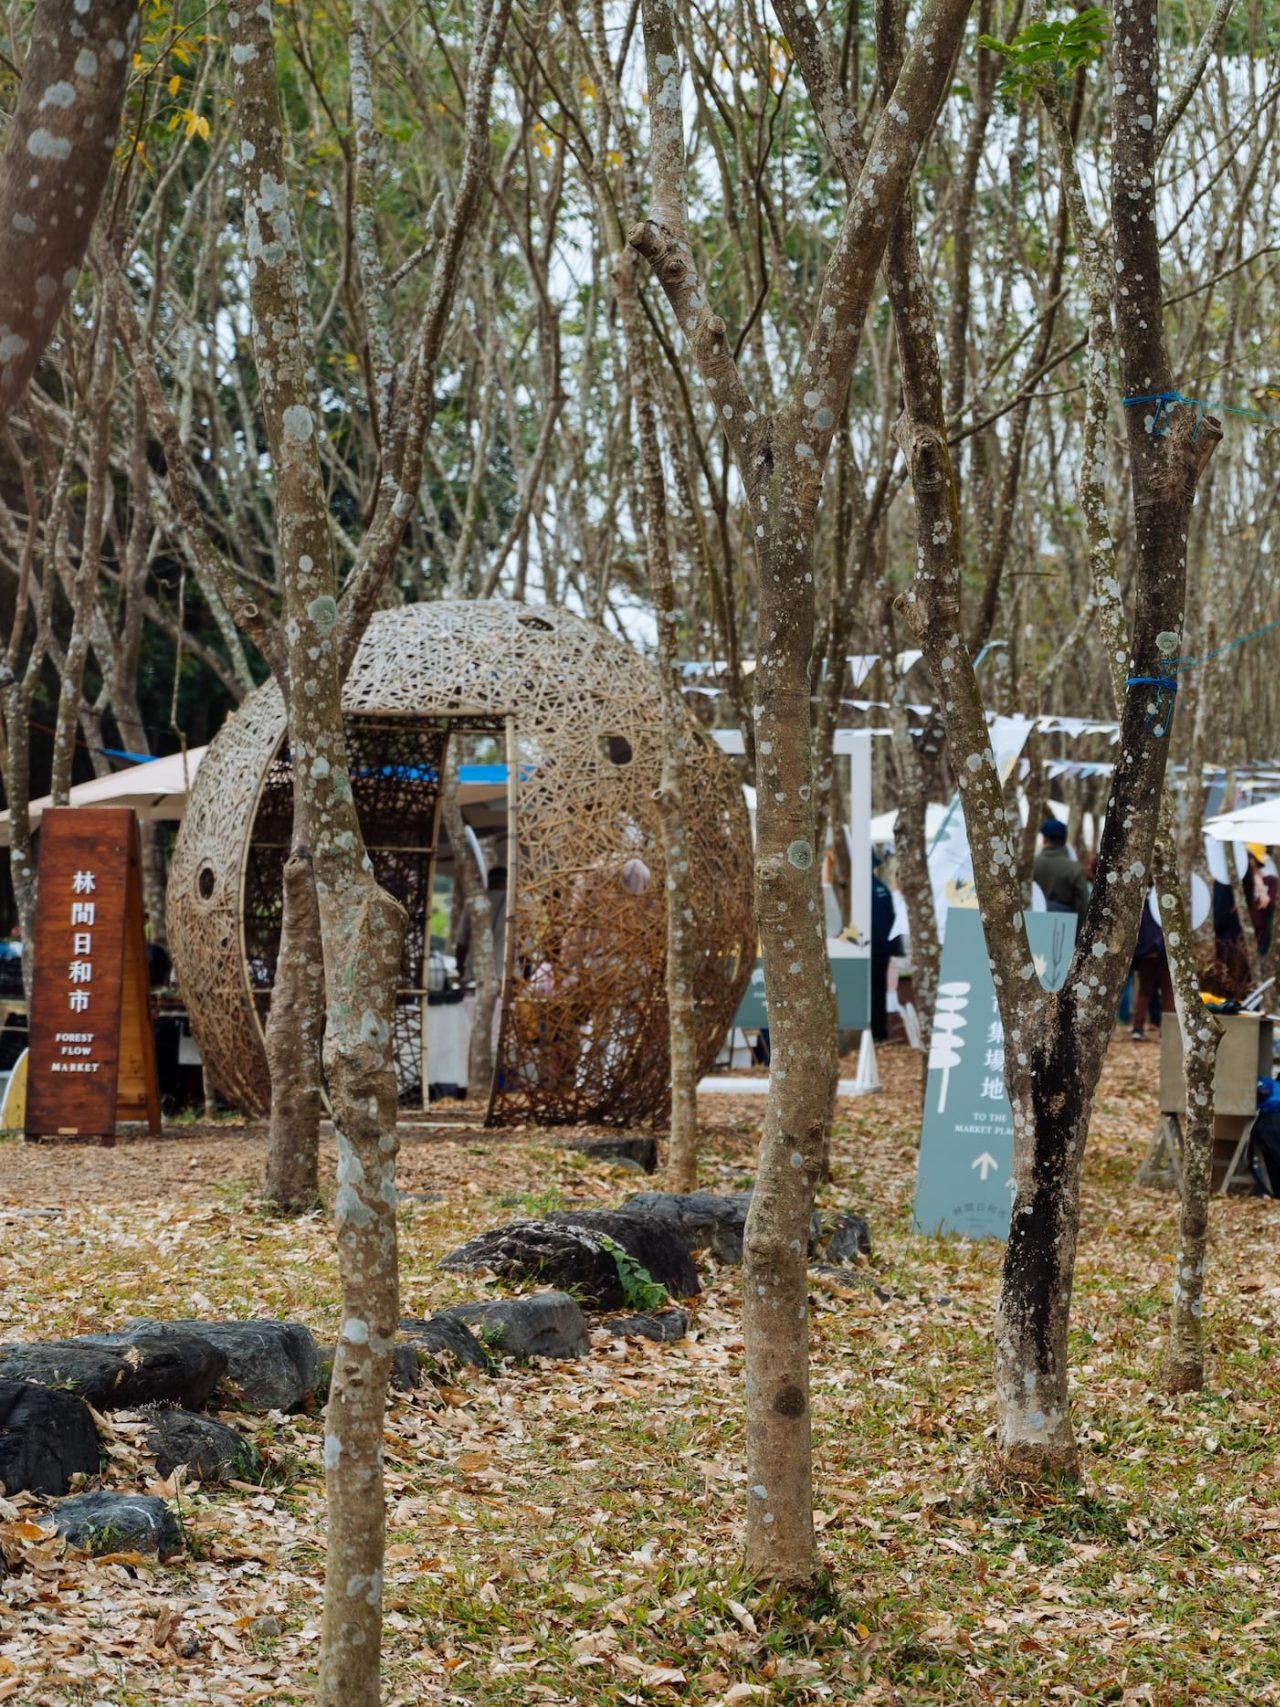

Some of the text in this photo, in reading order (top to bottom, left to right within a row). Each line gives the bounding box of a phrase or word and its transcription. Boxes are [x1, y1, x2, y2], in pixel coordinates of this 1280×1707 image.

[68, 871, 96, 1014] 林間日和市
[55, 1033, 94, 1042] FOREST
[61, 1046, 91, 1055] FLOW
[51, 1063, 99, 1072] MARKET
[973, 1112, 1007, 1122] TO THE
[954, 1124, 993, 1135] MARKET
